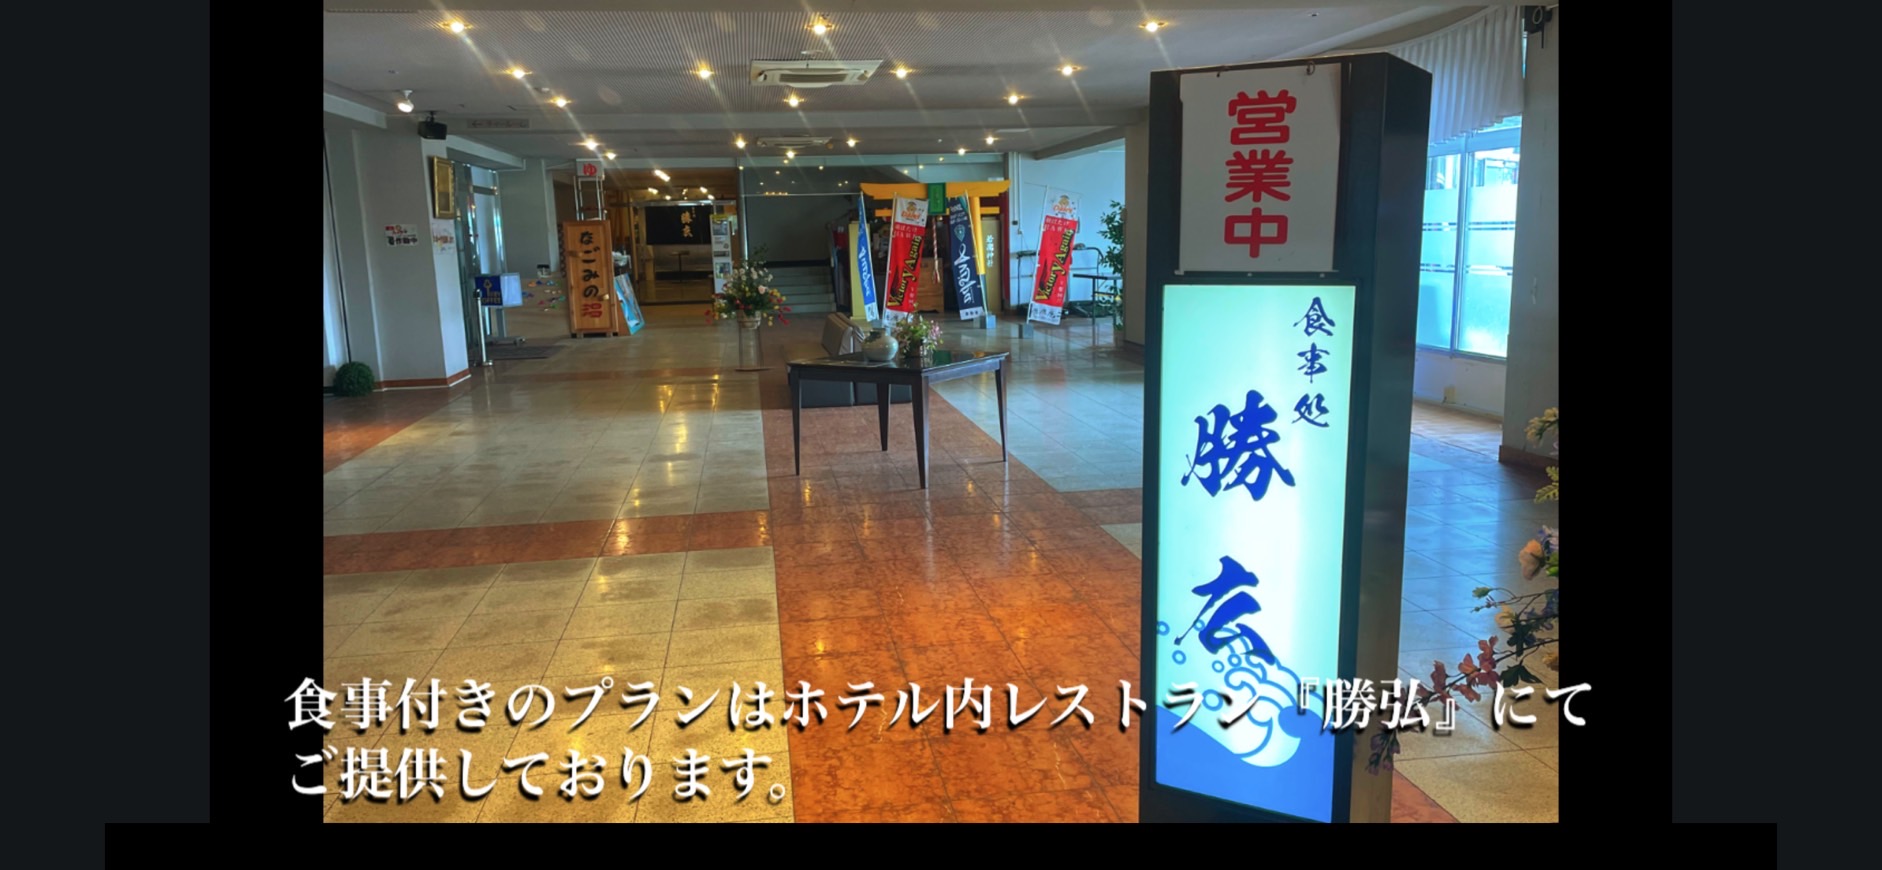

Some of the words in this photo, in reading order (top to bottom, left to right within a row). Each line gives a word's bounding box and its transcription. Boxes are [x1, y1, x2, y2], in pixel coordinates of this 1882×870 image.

[583, 163, 597, 176] ゆ
[1224, 89, 1297, 259] 営業中
[579, 231, 603, 318] なごみの湯
[1291, 297, 1335, 428] 食事処
[1174, 389, 1296, 666] 勝広
